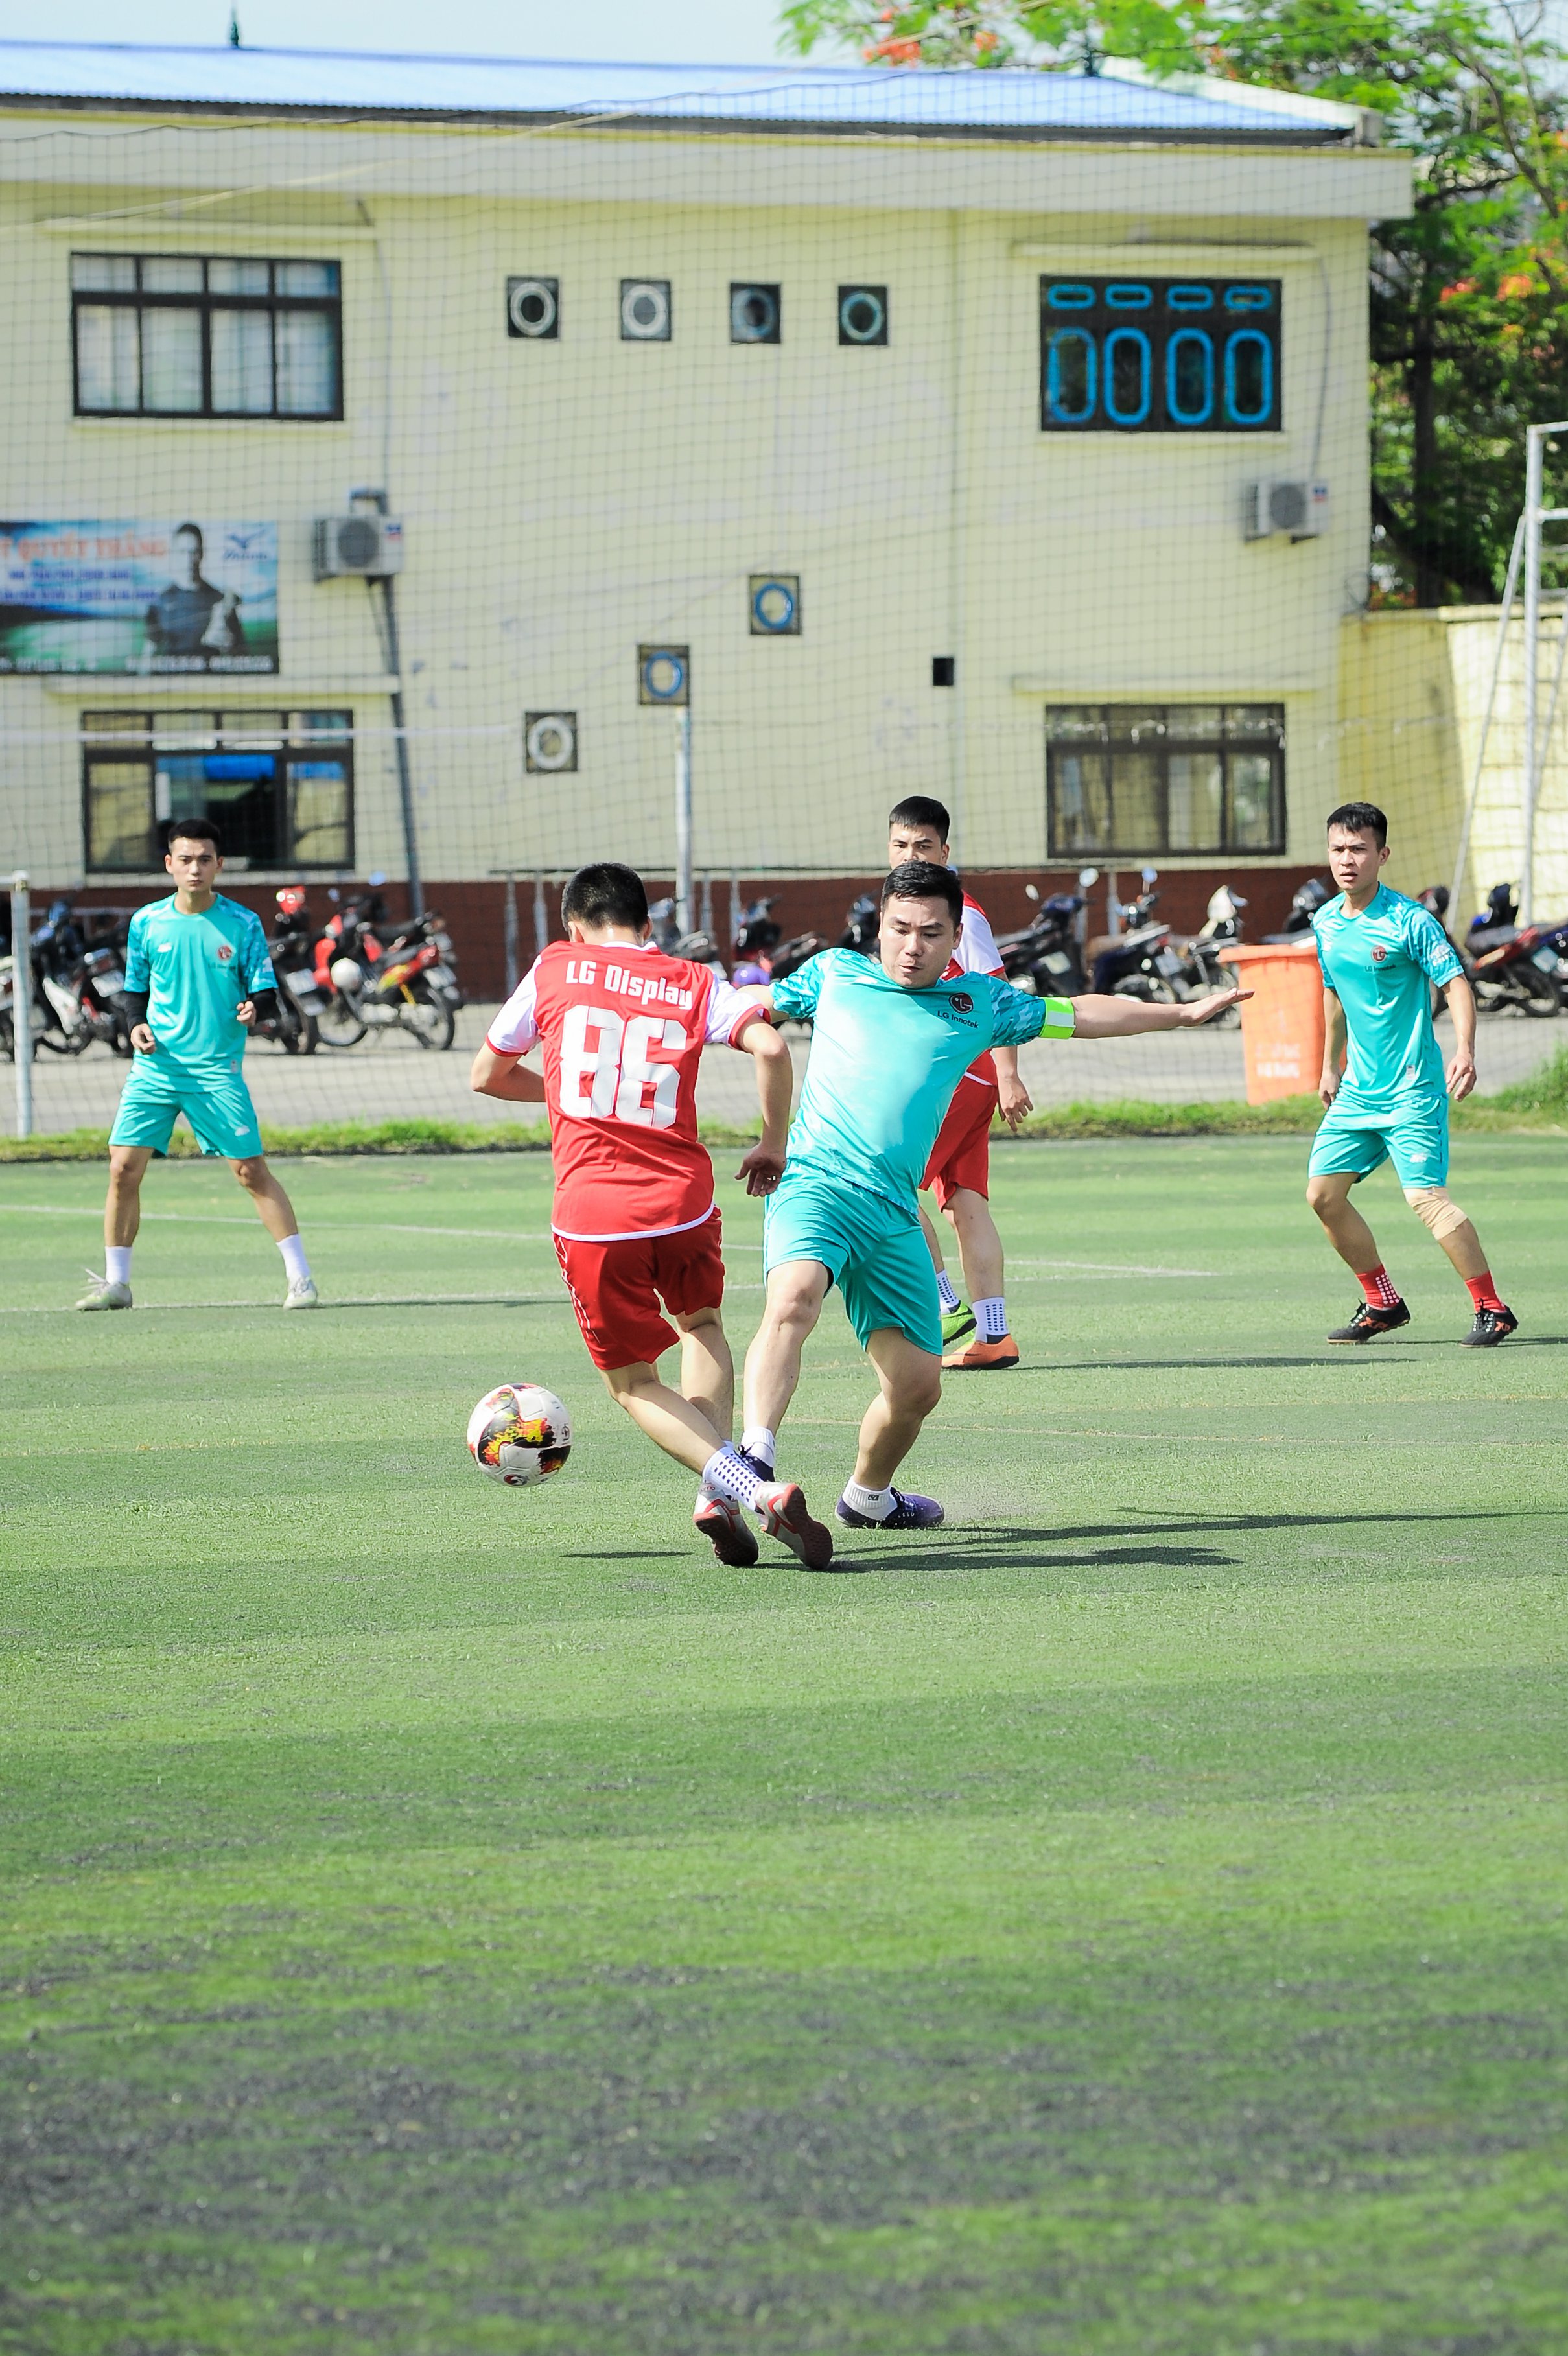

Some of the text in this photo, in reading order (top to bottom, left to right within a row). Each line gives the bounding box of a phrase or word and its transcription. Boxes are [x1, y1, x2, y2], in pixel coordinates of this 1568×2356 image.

[566, 961, 692, 1010] LG Display
[937, 1010, 979, 1029] LG Innotek
[559, 1005, 687, 1129] 86
